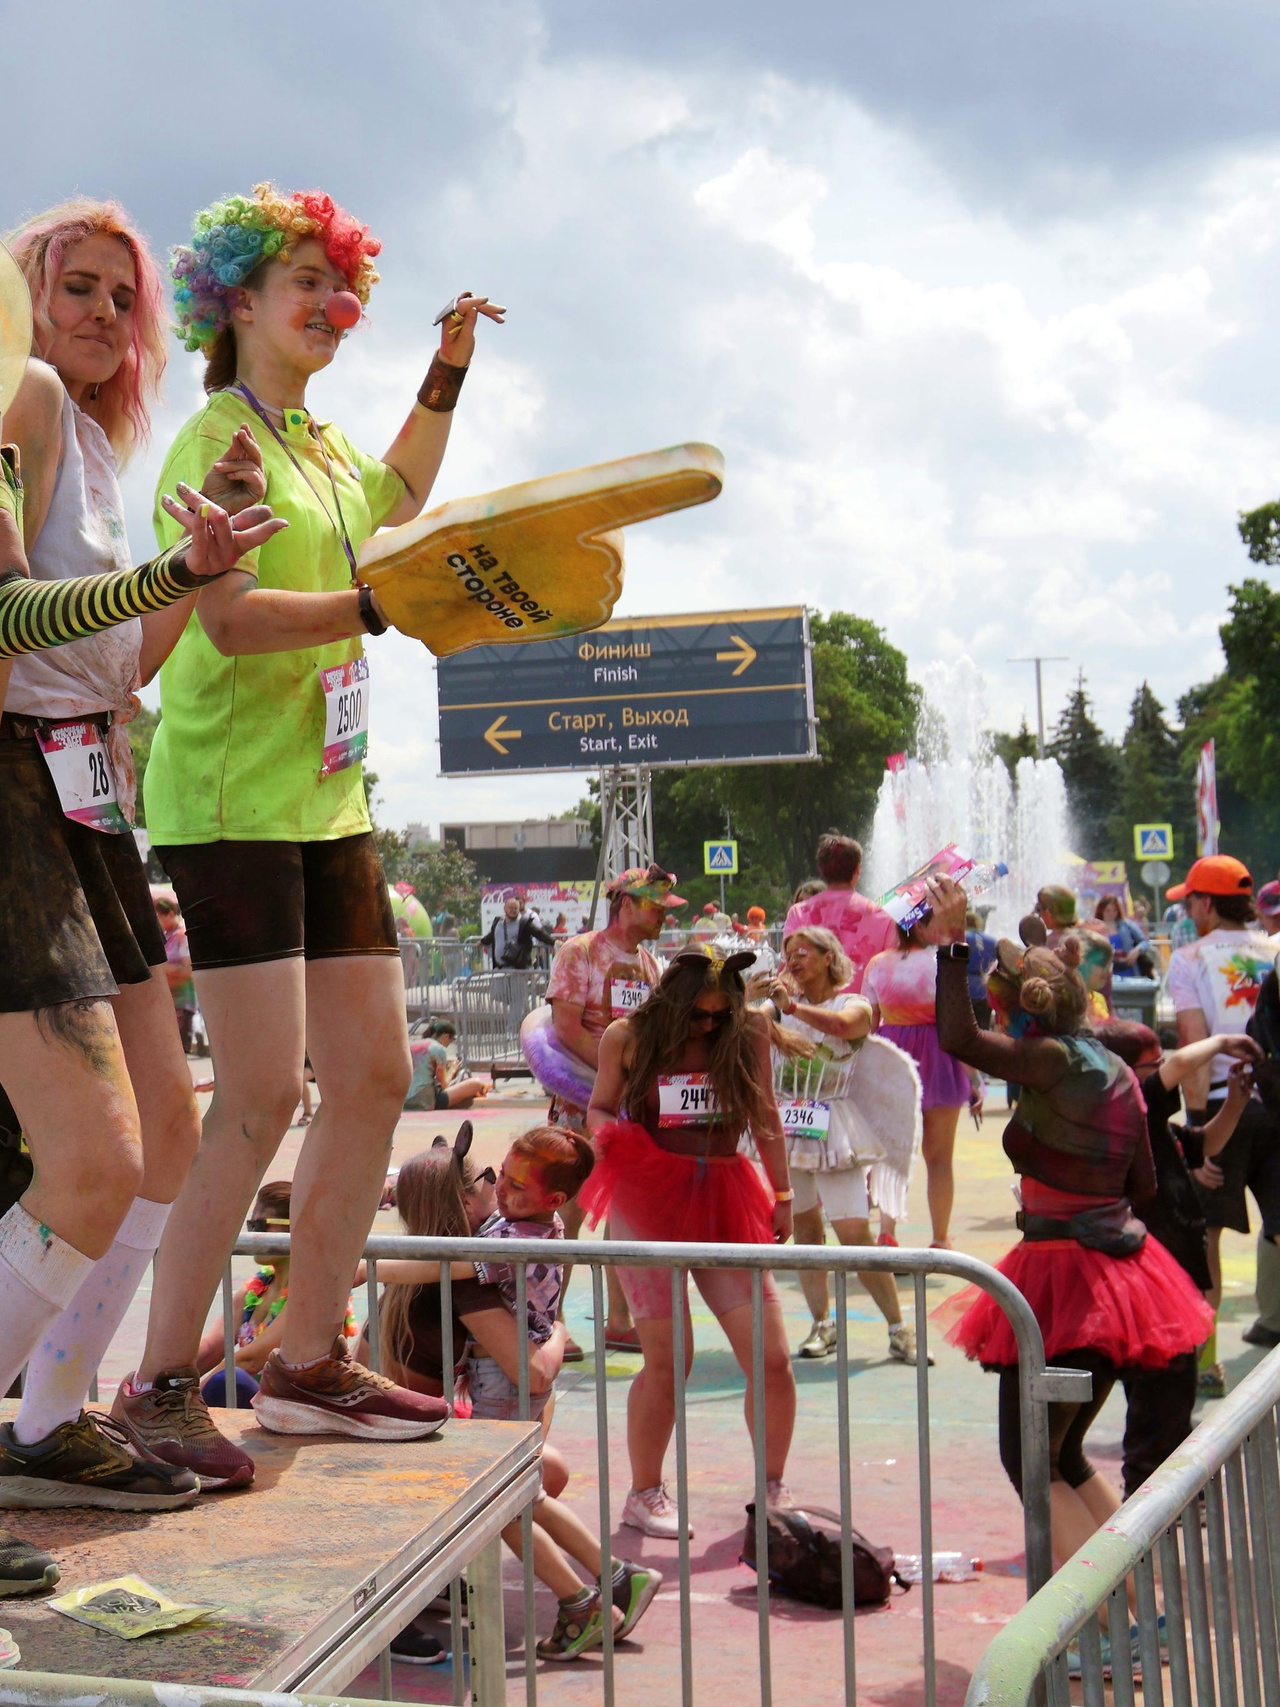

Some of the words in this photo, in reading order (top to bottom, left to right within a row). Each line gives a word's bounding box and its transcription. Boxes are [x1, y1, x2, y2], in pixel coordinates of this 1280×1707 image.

[446, 554, 524, 629] стороне
[467, 544, 499, 572] на
[493, 571, 554, 623] твоей
[578, 642, 652, 661] Финиш
[593, 665, 638, 682] Finish
[337, 687, 362, 736] 2500
[548, 711, 613, 733] Старт,
[622, 707, 689, 727] Выход
[580, 736, 623, 752] Start,
[628, 733, 659, 749] Exit
[88, 750, 110, 798] 28
[784, 1109, 814, 1126] 2346
